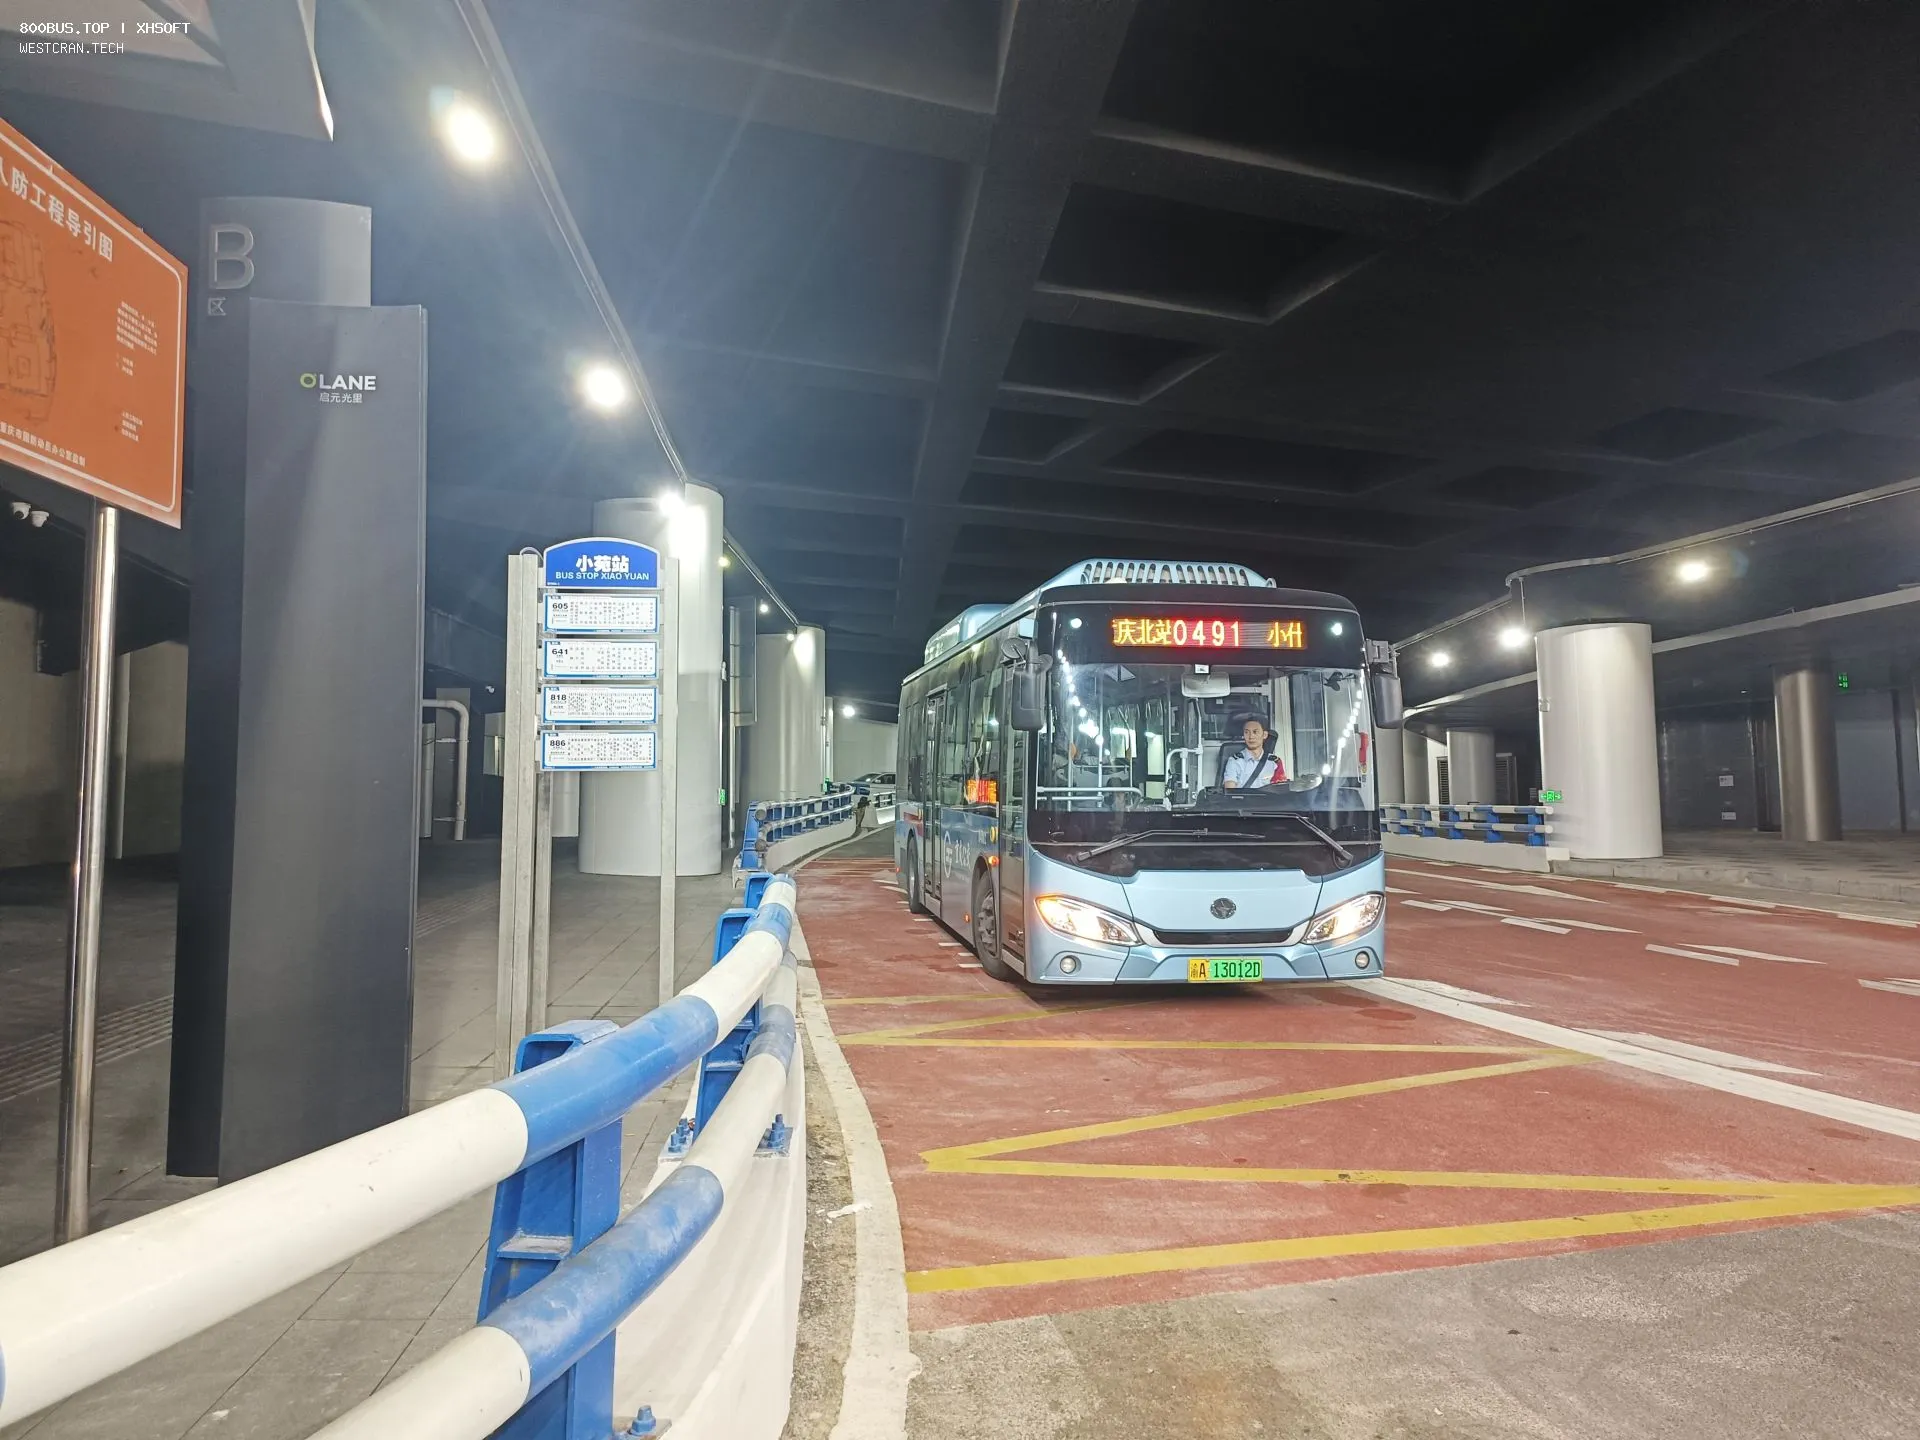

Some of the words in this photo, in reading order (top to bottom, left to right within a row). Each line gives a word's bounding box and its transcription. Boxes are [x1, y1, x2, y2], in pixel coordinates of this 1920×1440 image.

[208, 223, 254, 290] B
[320, 392, 363, 403] 启元光里
[576, 554, 629, 573] 小苑站
[555, 571, 574, 580] BUS
[576, 571, 600, 580] STOP
[601, 572, 623, 581] XIAO
[624, 573, 650, 581] YUAN
[552, 602, 569, 610] 605
[1112, 618, 1172, 645] 庆北站
[552, 648, 569, 656] 641
[550, 693, 567, 701] 818
[549, 739, 566, 747] 886
[1213, 962, 1261, 978] 13012D
